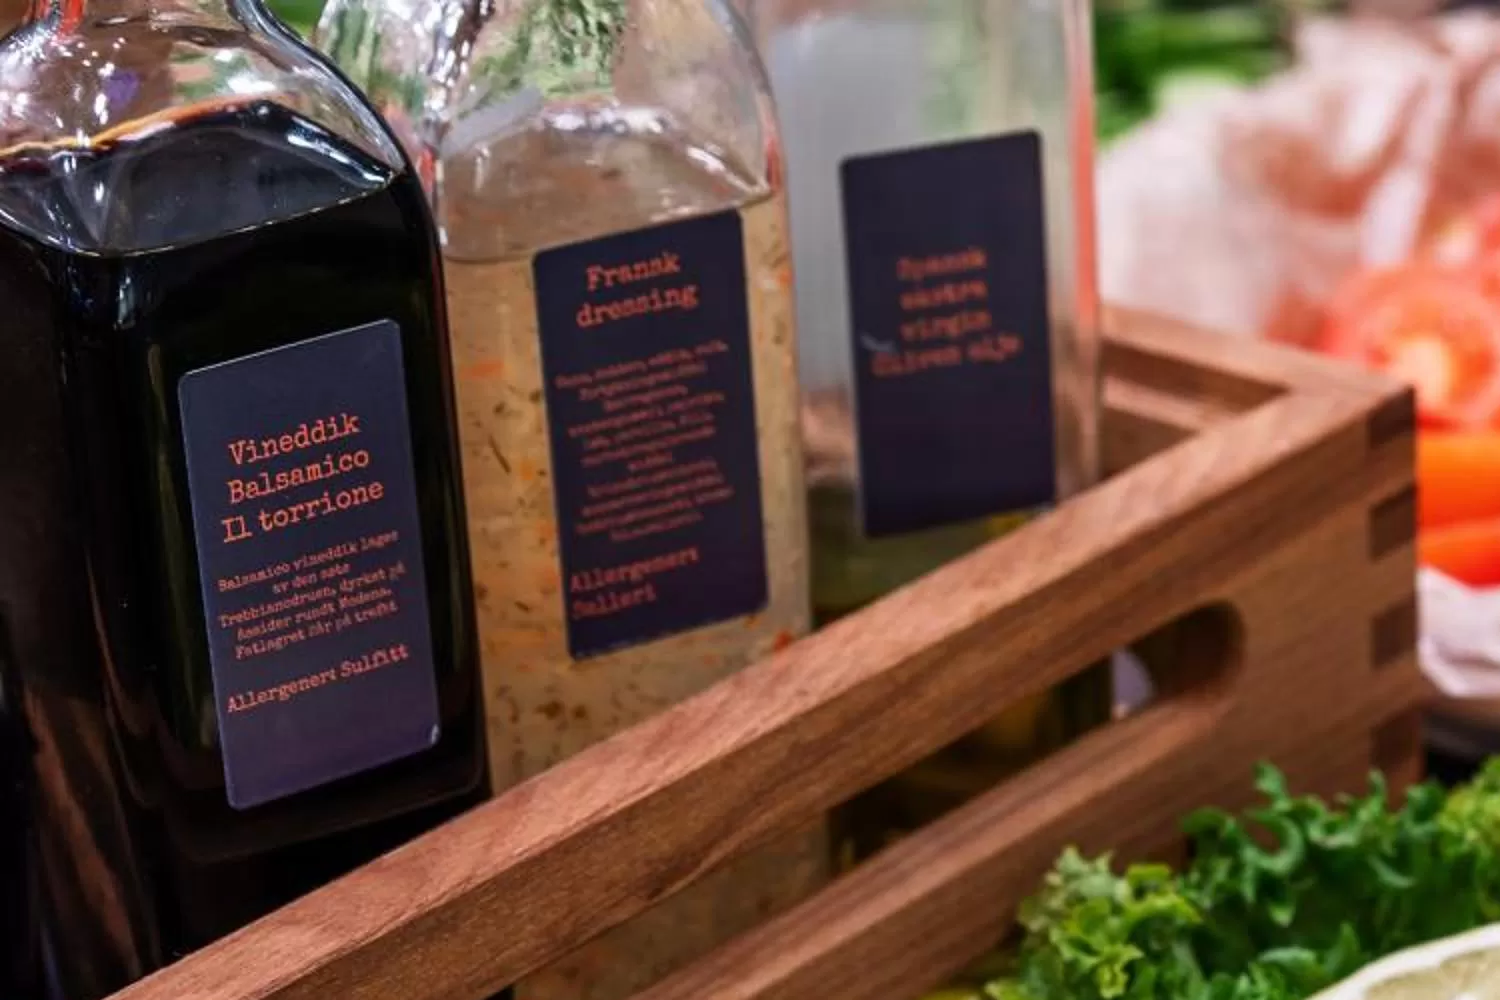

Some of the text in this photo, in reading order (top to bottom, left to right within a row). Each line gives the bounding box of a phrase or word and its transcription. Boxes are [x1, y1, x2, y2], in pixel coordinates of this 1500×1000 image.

[587, 251, 682, 292] Fransk
[575, 284, 699, 328] dressing
[228, 412, 362, 466] Vineddik
[226, 449, 370, 505] Balsamico
[221, 481, 385, 543] Il torrione
[339, 643, 410, 678] Sulfitt
